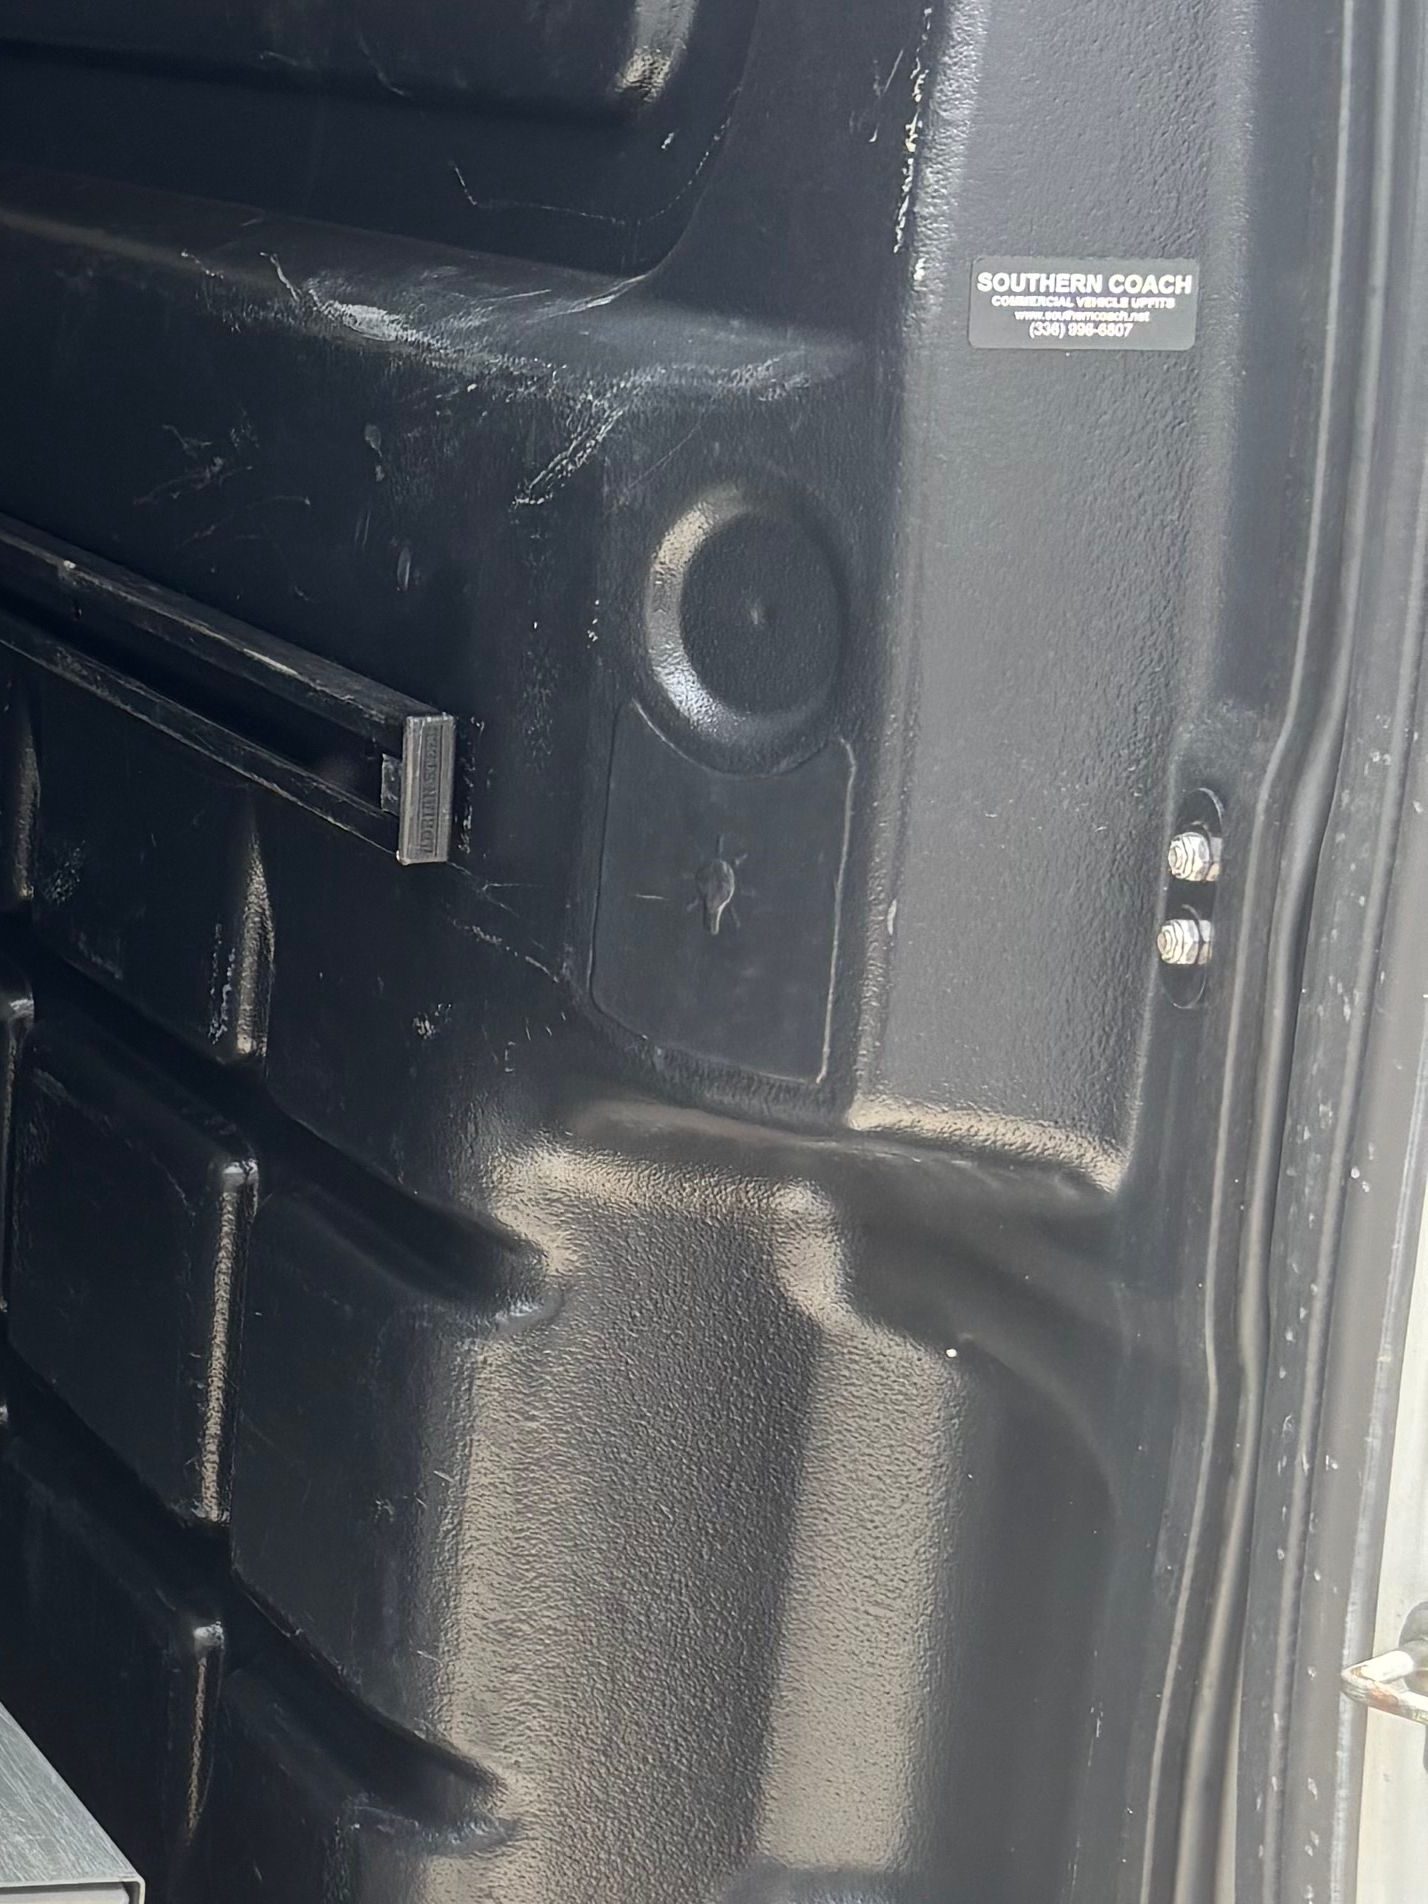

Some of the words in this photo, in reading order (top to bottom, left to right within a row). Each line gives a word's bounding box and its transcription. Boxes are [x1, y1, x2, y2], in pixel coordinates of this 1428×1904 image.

[977, 272, 1102, 293] SOUTHERN
[1108, 274, 1193, 295] COACH
[991, 296, 1074, 308] COMMERCIAL
[1076, 297, 1129, 309] VEHICLE
[1131, 298, 1175, 309] UPFITS
